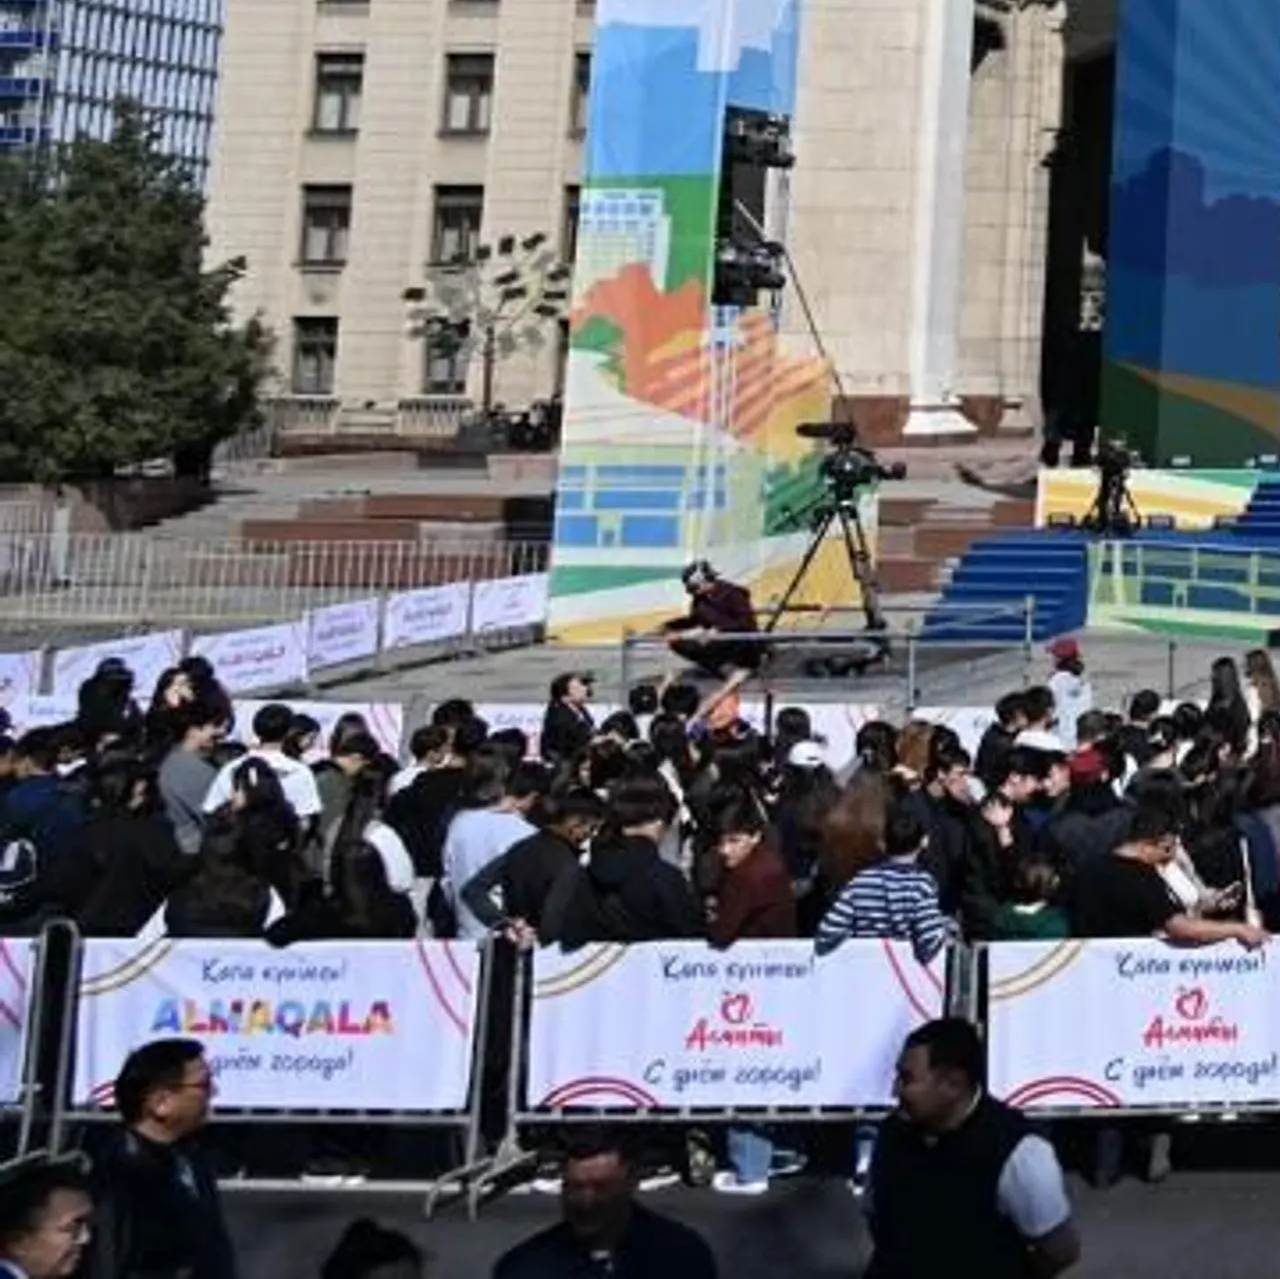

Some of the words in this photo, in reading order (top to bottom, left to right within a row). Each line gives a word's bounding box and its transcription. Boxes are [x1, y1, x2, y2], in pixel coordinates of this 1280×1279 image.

[150, 997, 395, 1037] ALMAQALA
[643, 1059, 666, 1084] С
[1104, 1058, 1124, 1082] С
